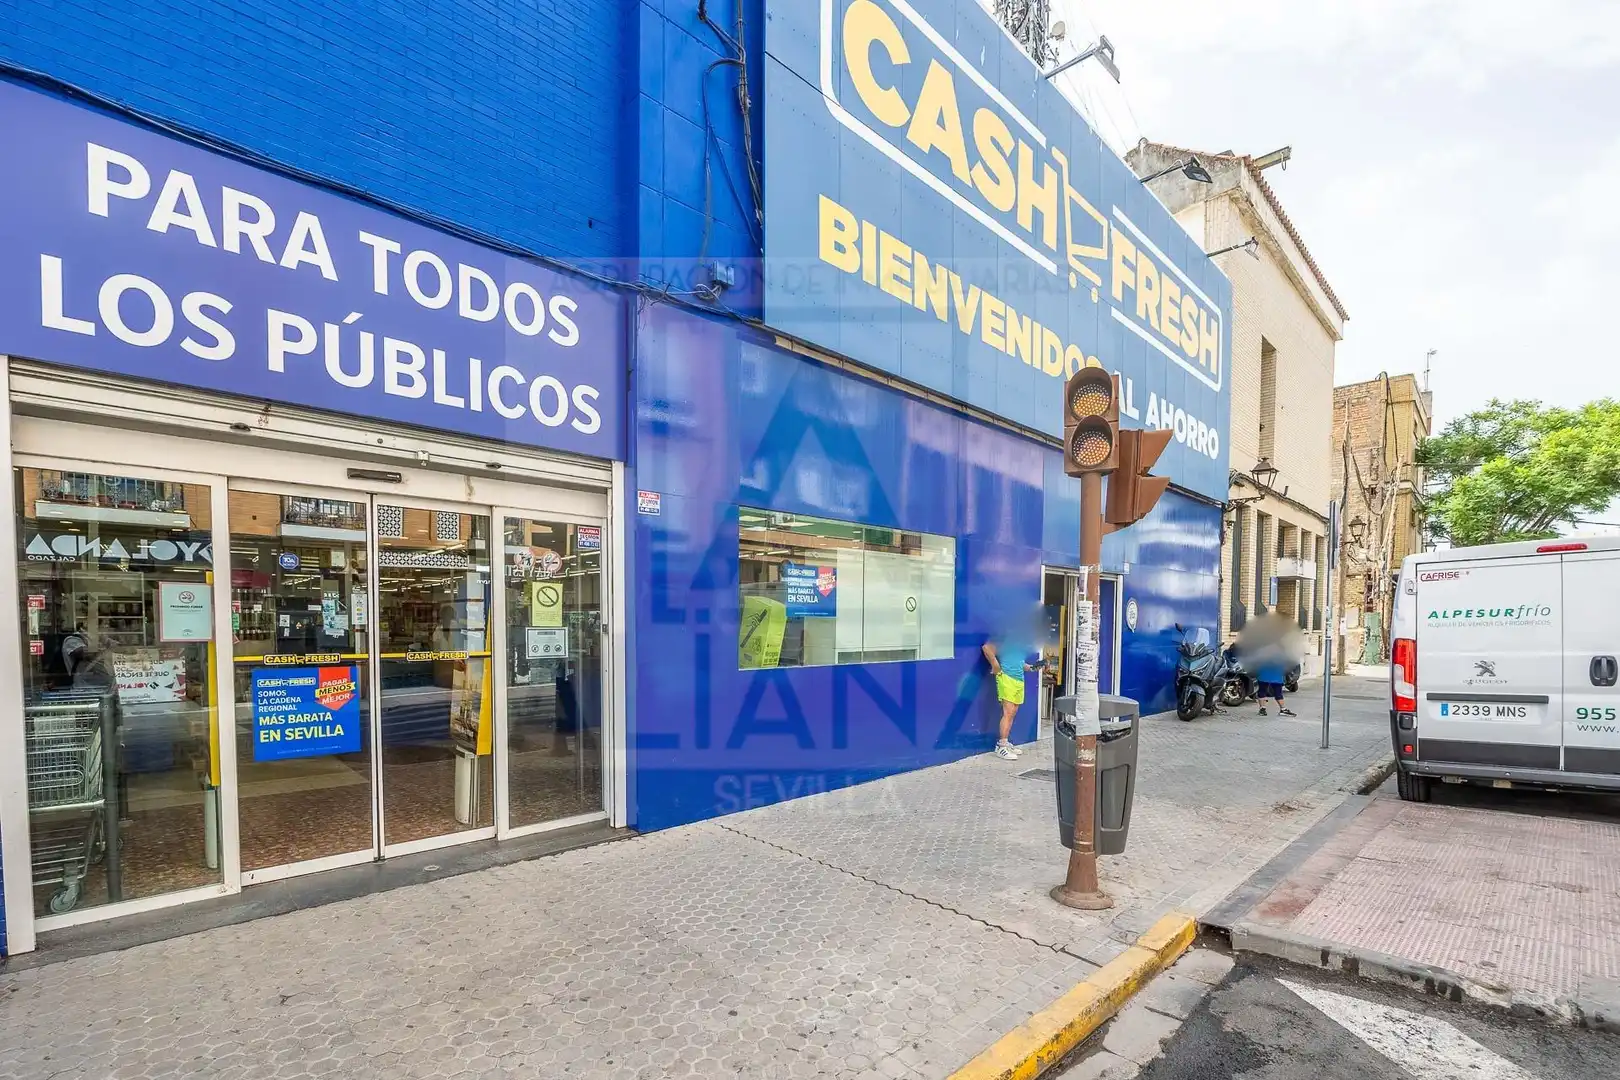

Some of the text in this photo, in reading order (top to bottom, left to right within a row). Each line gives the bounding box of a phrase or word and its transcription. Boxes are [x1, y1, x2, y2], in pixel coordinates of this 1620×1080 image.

[843, 0, 1218, 375] CASH FRESH
[86, 142, 581, 347] PARA TODOS
[818, 194, 1103, 380] BIENVENIDO
[1145, 391, 1219, 460] AHORRO
[40, 254, 602, 435] LOS PÚBLICOS
[1420, 571, 1460, 582] CAFRISE
[788, 594, 818, 603] EN SEVILLA
[306, 654, 338, 662] FRESH
[322, 678, 348, 688] PAGAR
[318, 684, 352, 696] MENOS
[322, 693, 350, 704] MEJOR
[259, 704, 298, 712] REGIONAL
[1452, 704, 1527, 718] 2339 MNS
[1576, 708, 1616, 720] 955
[259, 712, 332, 726] MÁS BARATA
[260, 724, 344, 742] EN SEVILLA
